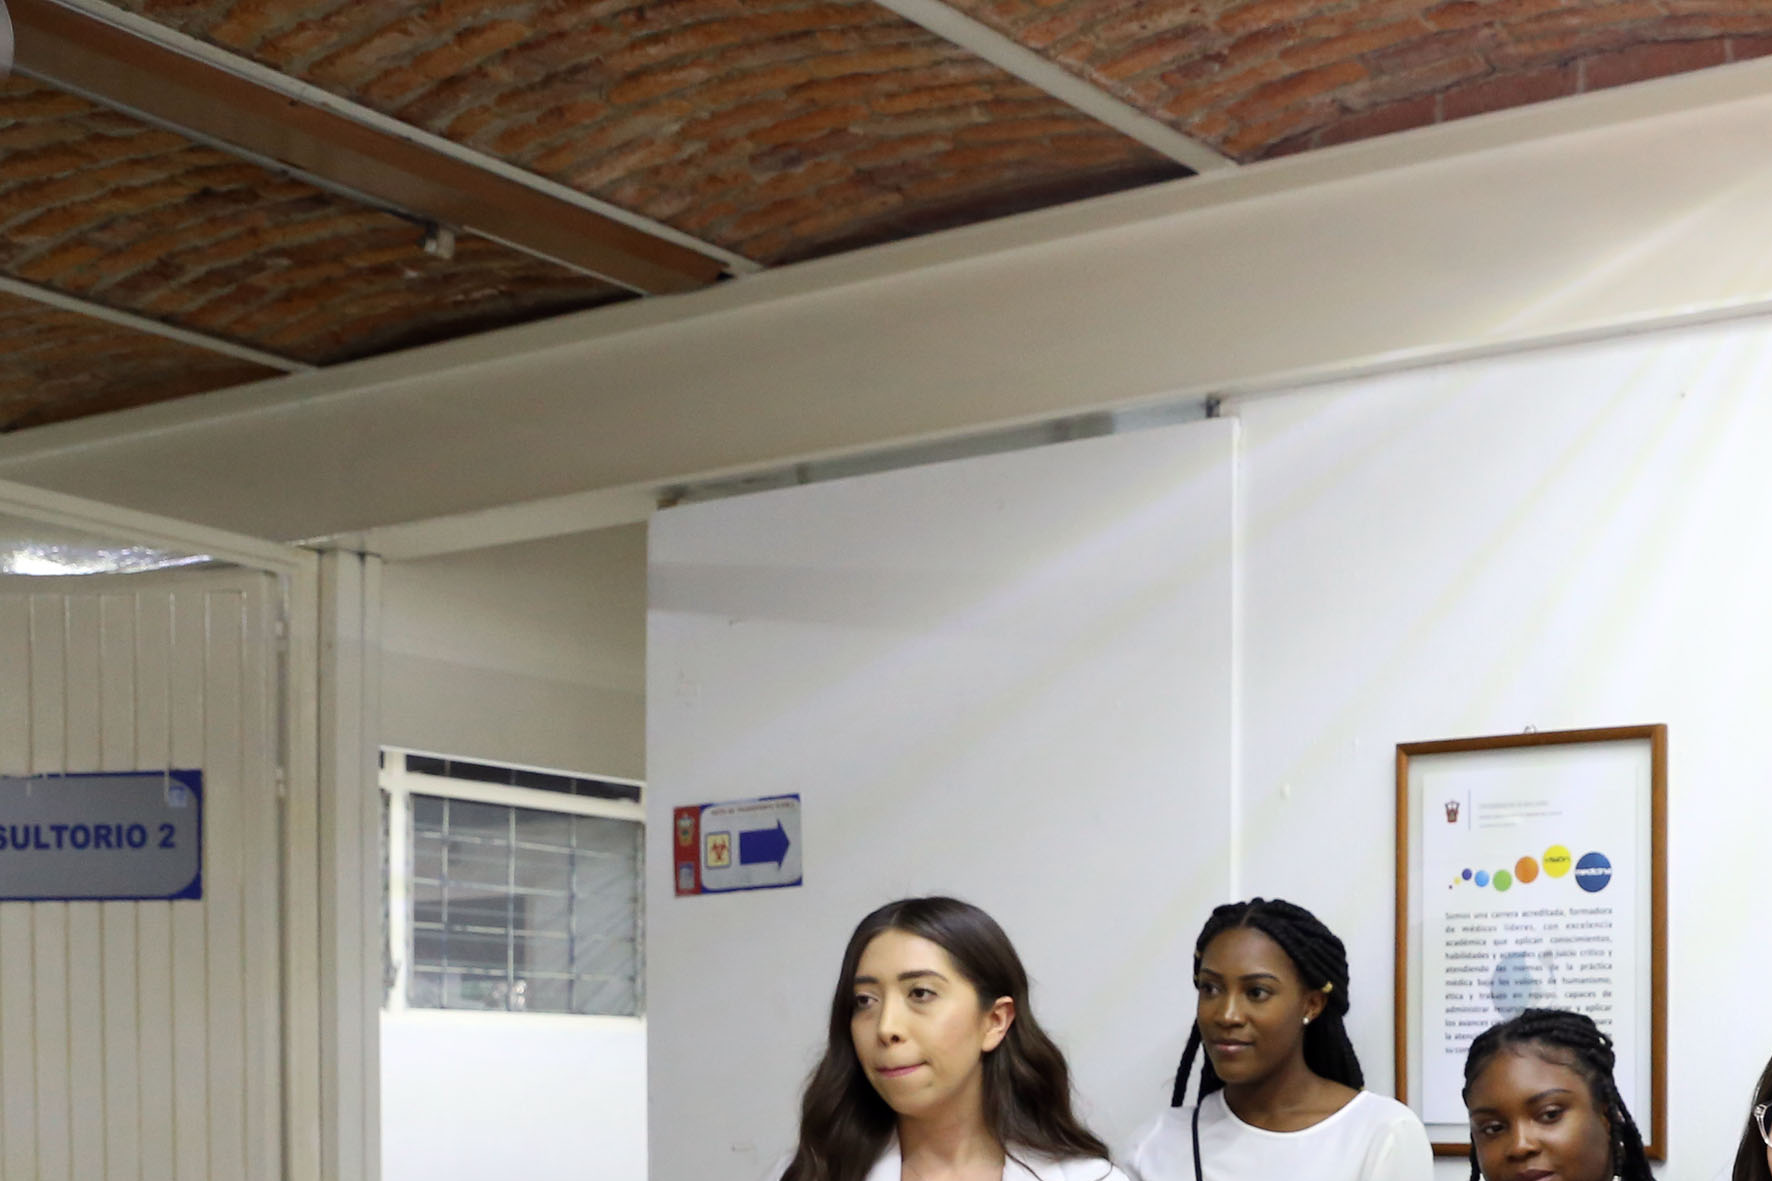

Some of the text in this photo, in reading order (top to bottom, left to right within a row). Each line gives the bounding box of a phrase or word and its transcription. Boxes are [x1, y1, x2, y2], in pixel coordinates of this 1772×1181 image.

[158, 824, 175, 849] 2
[1445, 925, 1455, 933] de
[1566, 962, 1573, 970] la
[1580, 961, 1612, 971] práctica
